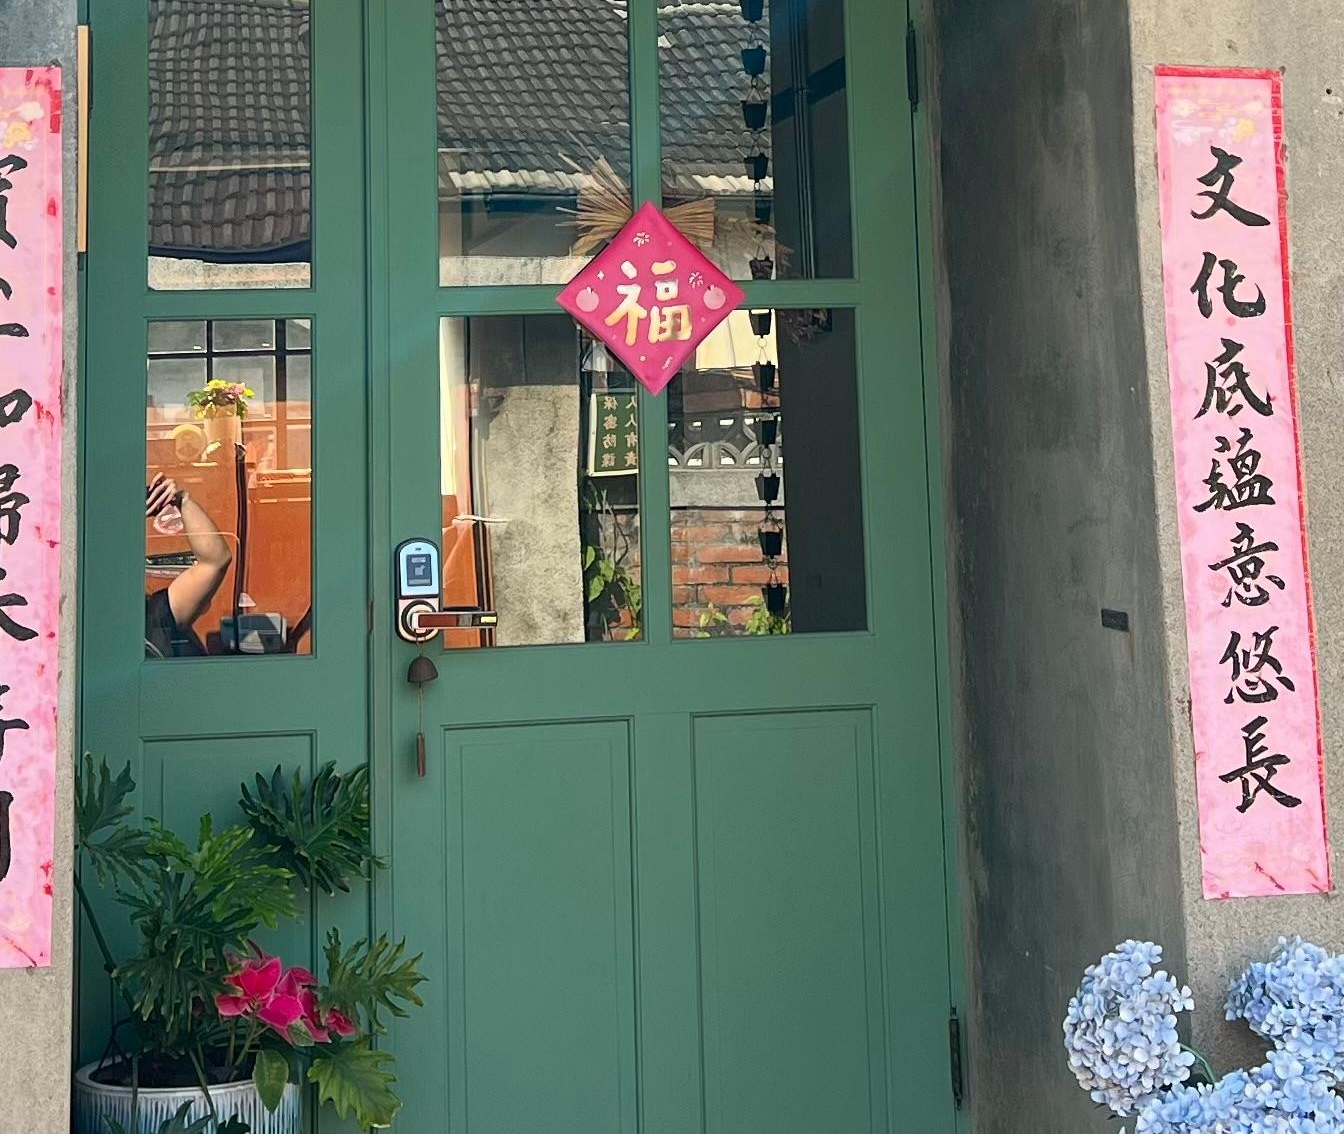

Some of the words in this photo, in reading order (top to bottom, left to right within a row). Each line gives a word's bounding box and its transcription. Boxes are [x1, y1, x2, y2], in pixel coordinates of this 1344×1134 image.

[604, 260, 693, 347] 福
[1190, 145, 1303, 814] 文化底蘊意悠長
